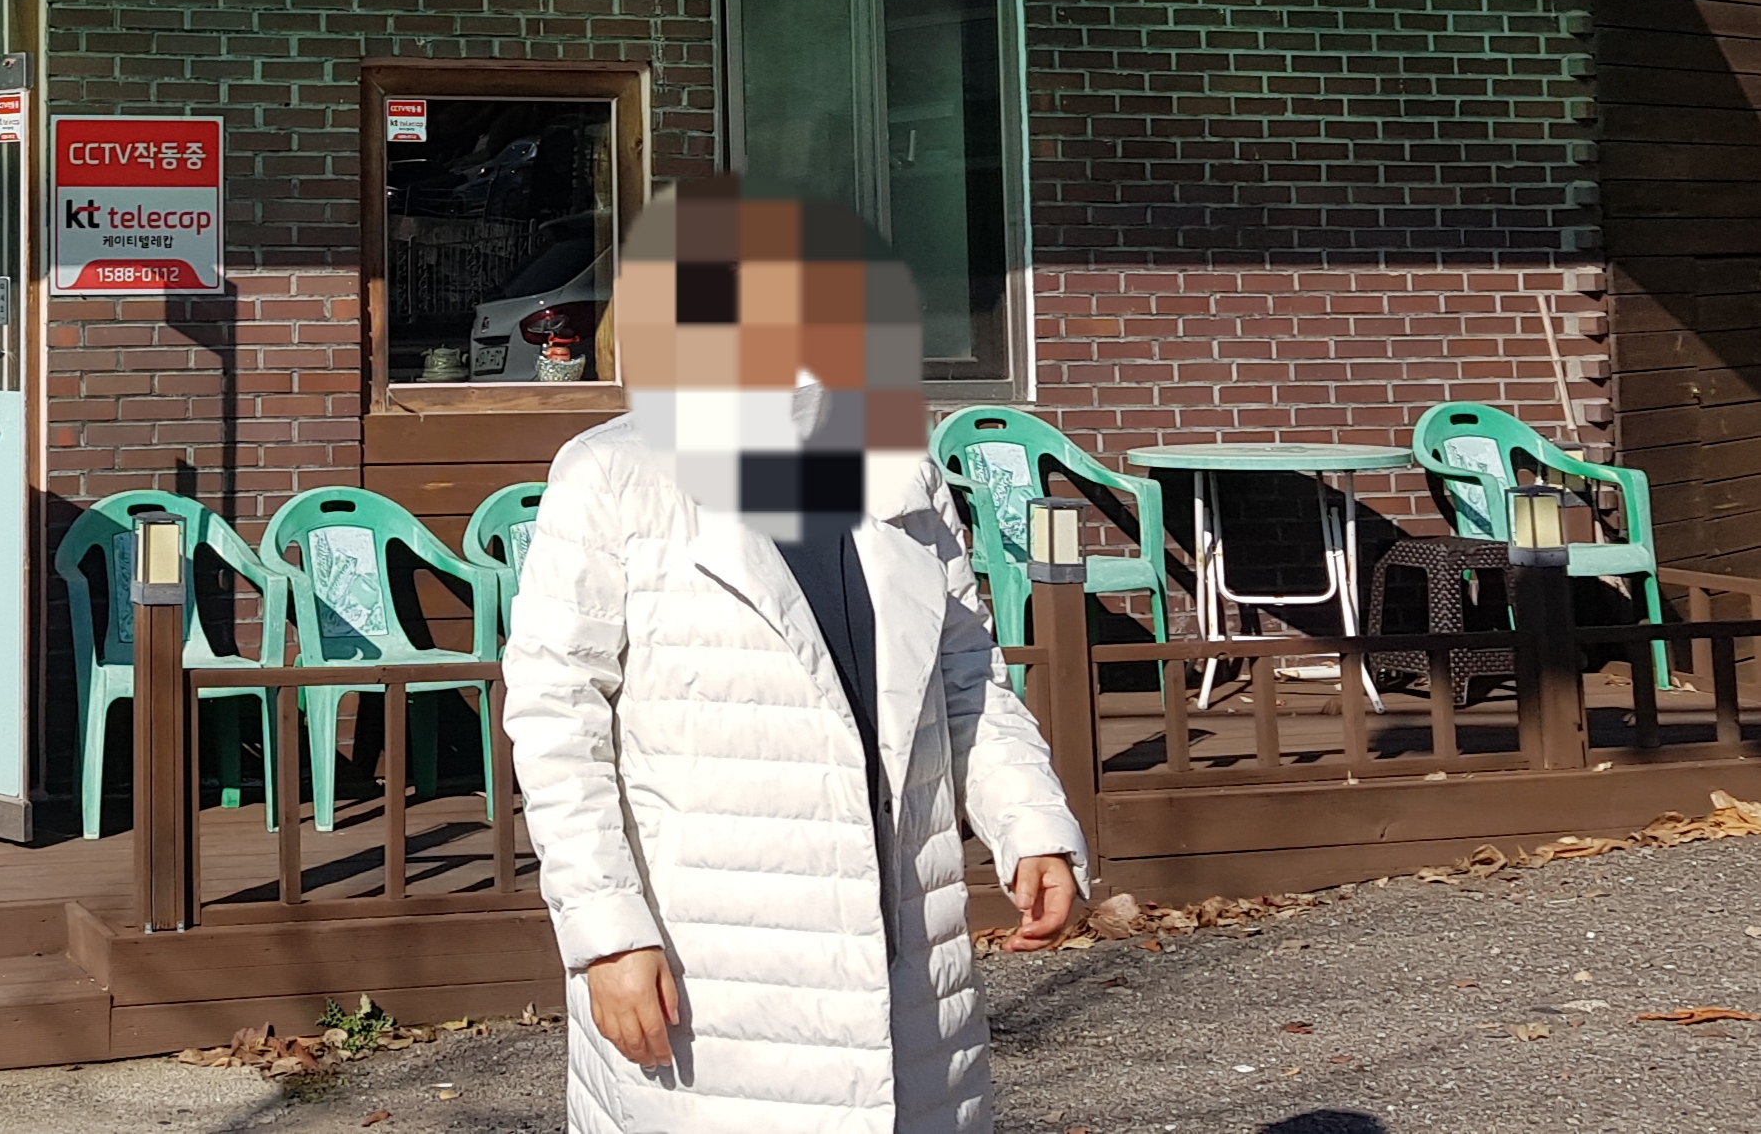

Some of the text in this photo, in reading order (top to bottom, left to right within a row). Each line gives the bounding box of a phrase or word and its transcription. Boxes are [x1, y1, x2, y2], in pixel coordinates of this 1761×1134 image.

[68, 141, 207, 170] CCTV작동중
[65, 199, 211, 236] kt telecop
[102, 235, 175, 249] 케이티텔레캅
[96, 267, 180, 282] 1588-0112
